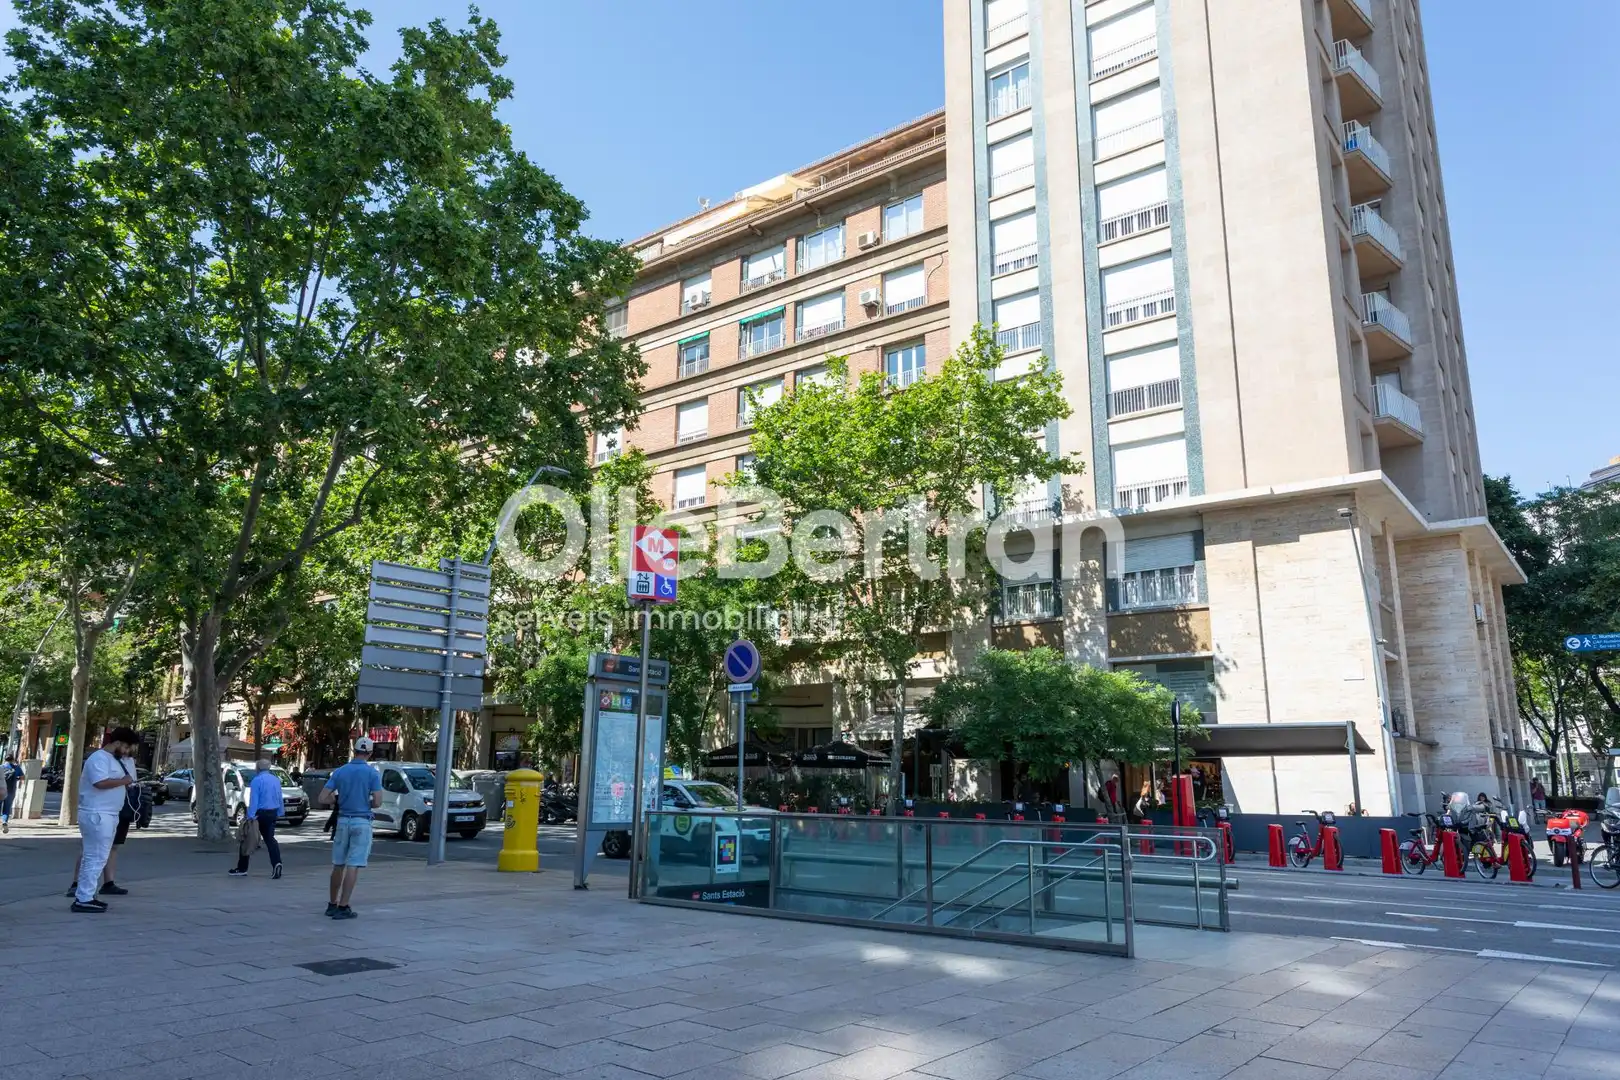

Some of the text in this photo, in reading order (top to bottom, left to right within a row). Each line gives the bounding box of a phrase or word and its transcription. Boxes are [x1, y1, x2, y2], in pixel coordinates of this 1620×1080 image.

[647, 537, 664, 553] M
[702, 888, 745, 900] Sants Estació
